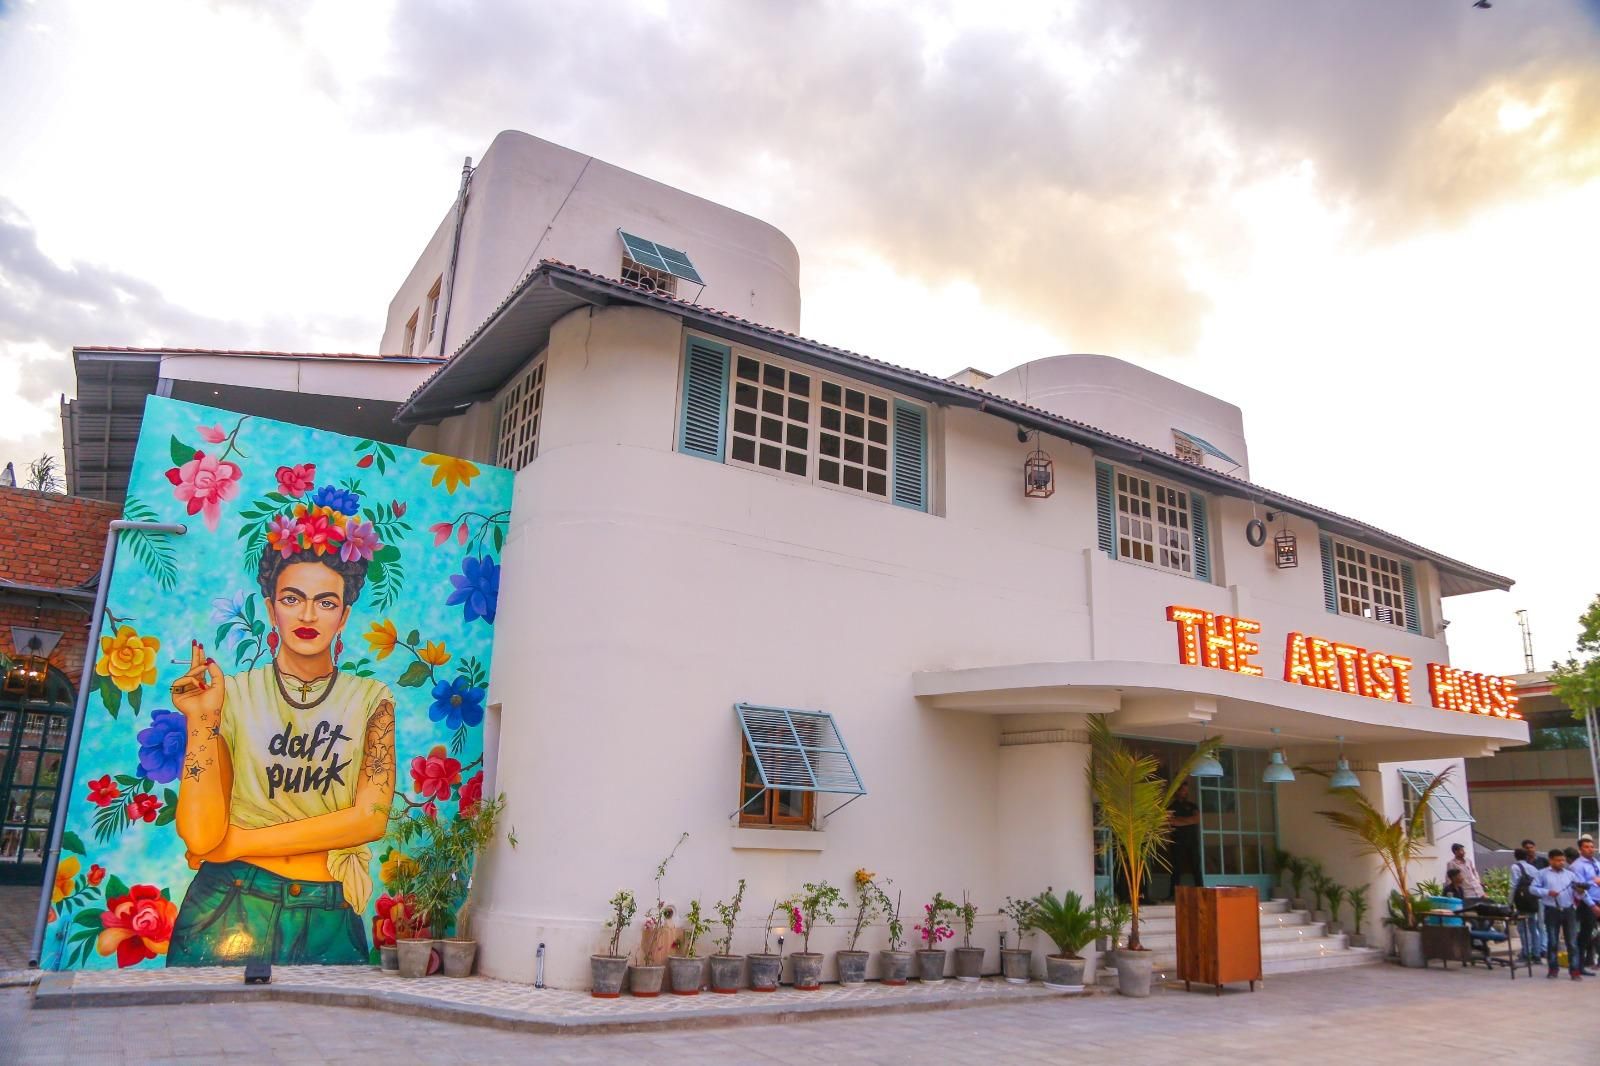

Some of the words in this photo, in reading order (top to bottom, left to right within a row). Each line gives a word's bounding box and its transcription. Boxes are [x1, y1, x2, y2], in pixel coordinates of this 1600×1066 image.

[1166, 606, 1264, 677] THE
[1284, 632, 1412, 704] ARTIST
[1427, 663, 1523, 720] HOUSE
[268, 721, 352, 762] daft
[266, 753, 352, 799] punk
